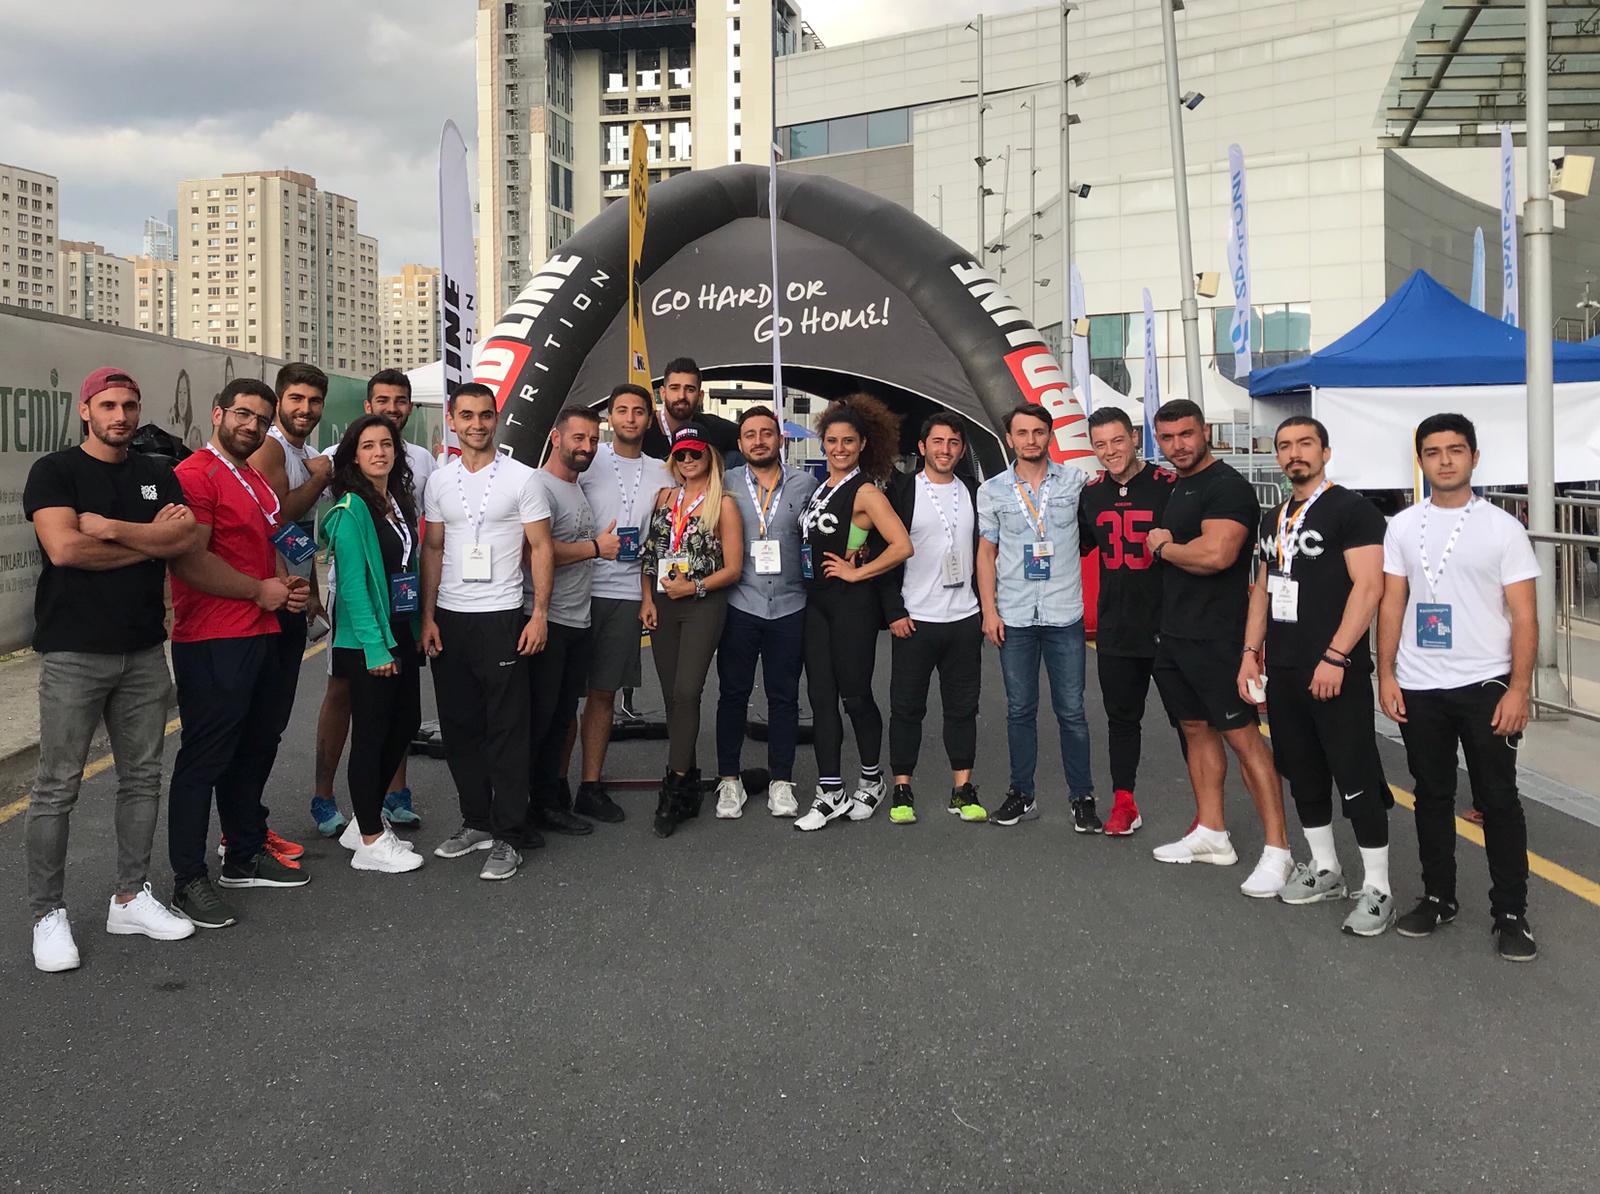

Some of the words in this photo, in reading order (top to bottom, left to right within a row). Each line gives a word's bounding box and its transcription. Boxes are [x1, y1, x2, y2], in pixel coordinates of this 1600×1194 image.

[651, 288, 690, 316] GO
[698, 283, 772, 311] HARD
[786, 280, 827, 301] OR
[754, 314, 793, 343] GO
[800, 297, 890, 334] HOME!
[1096, 510, 1154, 570] 35
